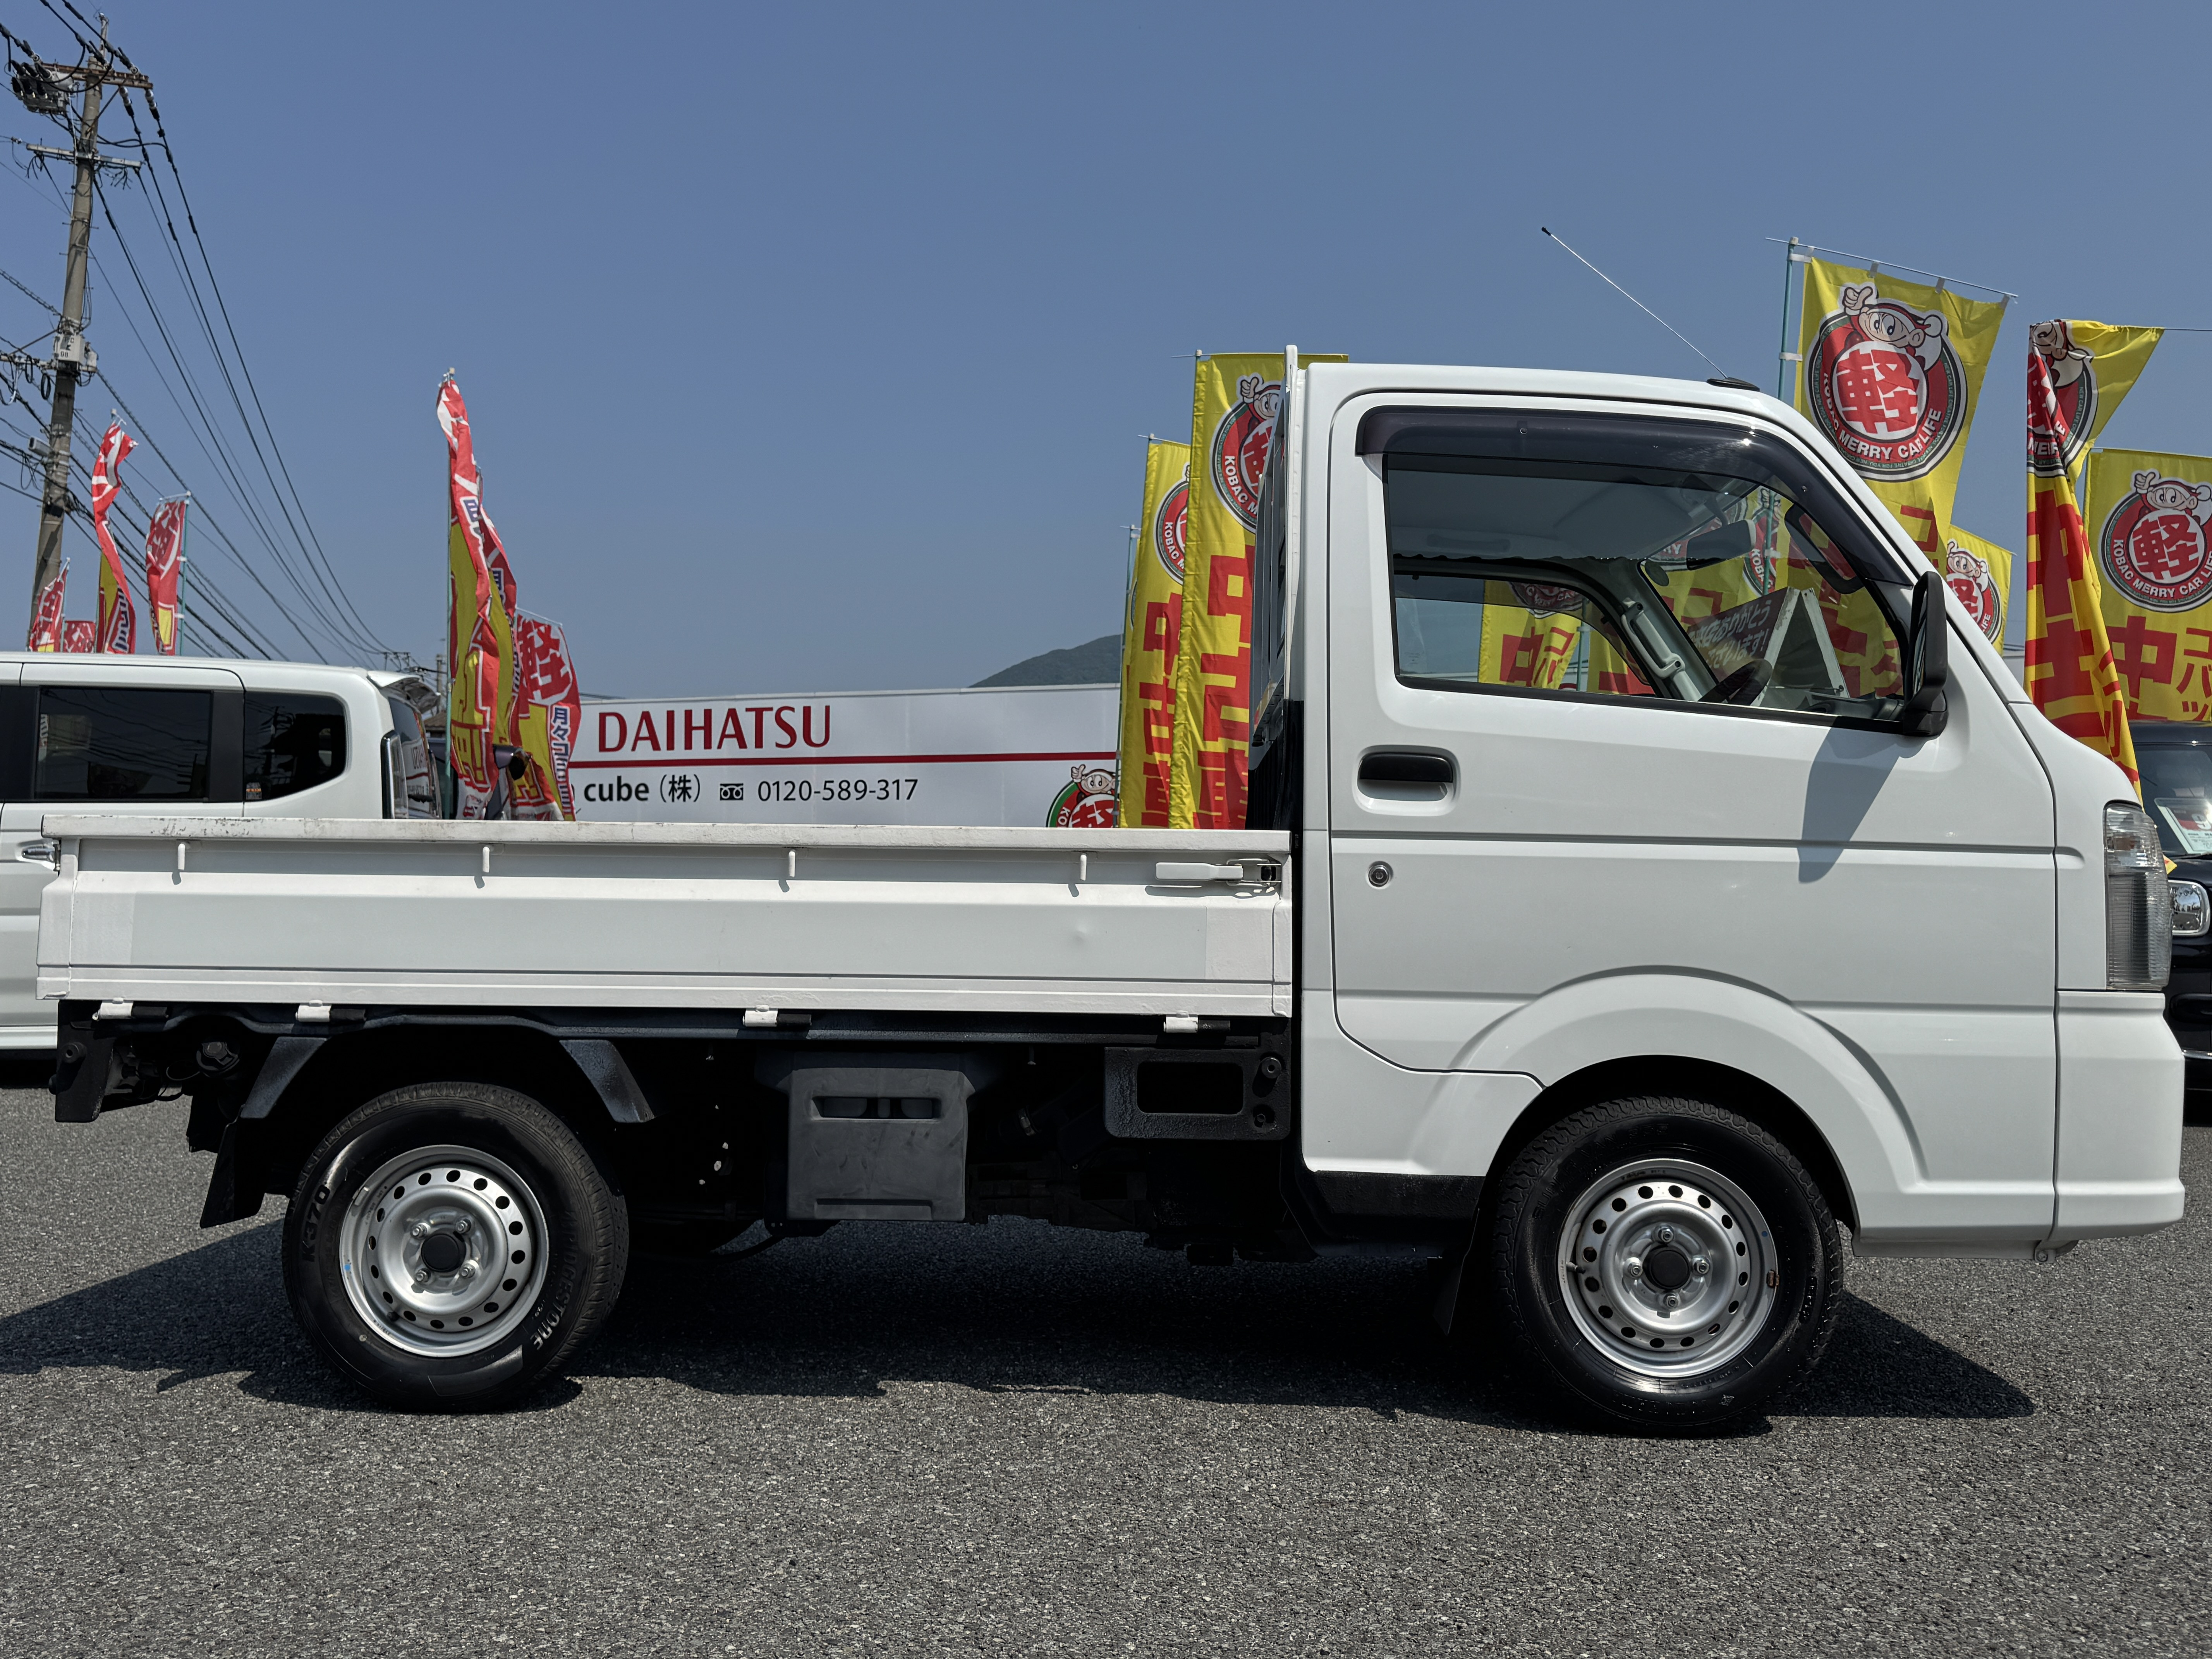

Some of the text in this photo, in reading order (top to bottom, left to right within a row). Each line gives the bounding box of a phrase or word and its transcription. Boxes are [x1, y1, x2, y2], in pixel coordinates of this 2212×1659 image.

[1837, 349, 1919, 434] 軽
[1839, 429, 1892, 460] MERRY
[1922, 408, 1942, 443] LIFE
[1224, 455, 1249, 504] KOBAC
[1164, 521, 1180, 560] KOBAC
[2133, 514, 2199, 580] 軽
[2113, 539, 2134, 580] KOBAC
[2133, 578, 2176, 598] MERRY
[2179, 577, 2203, 595] CAR
[1982, 613, 1991, 632] IFE
[599, 706, 830, 752] DAIHATSU
[584, 776, 649, 802] cube
[758, 779, 918, 802] 0120-589-317
[302, 1185, 331, 1262] K370
